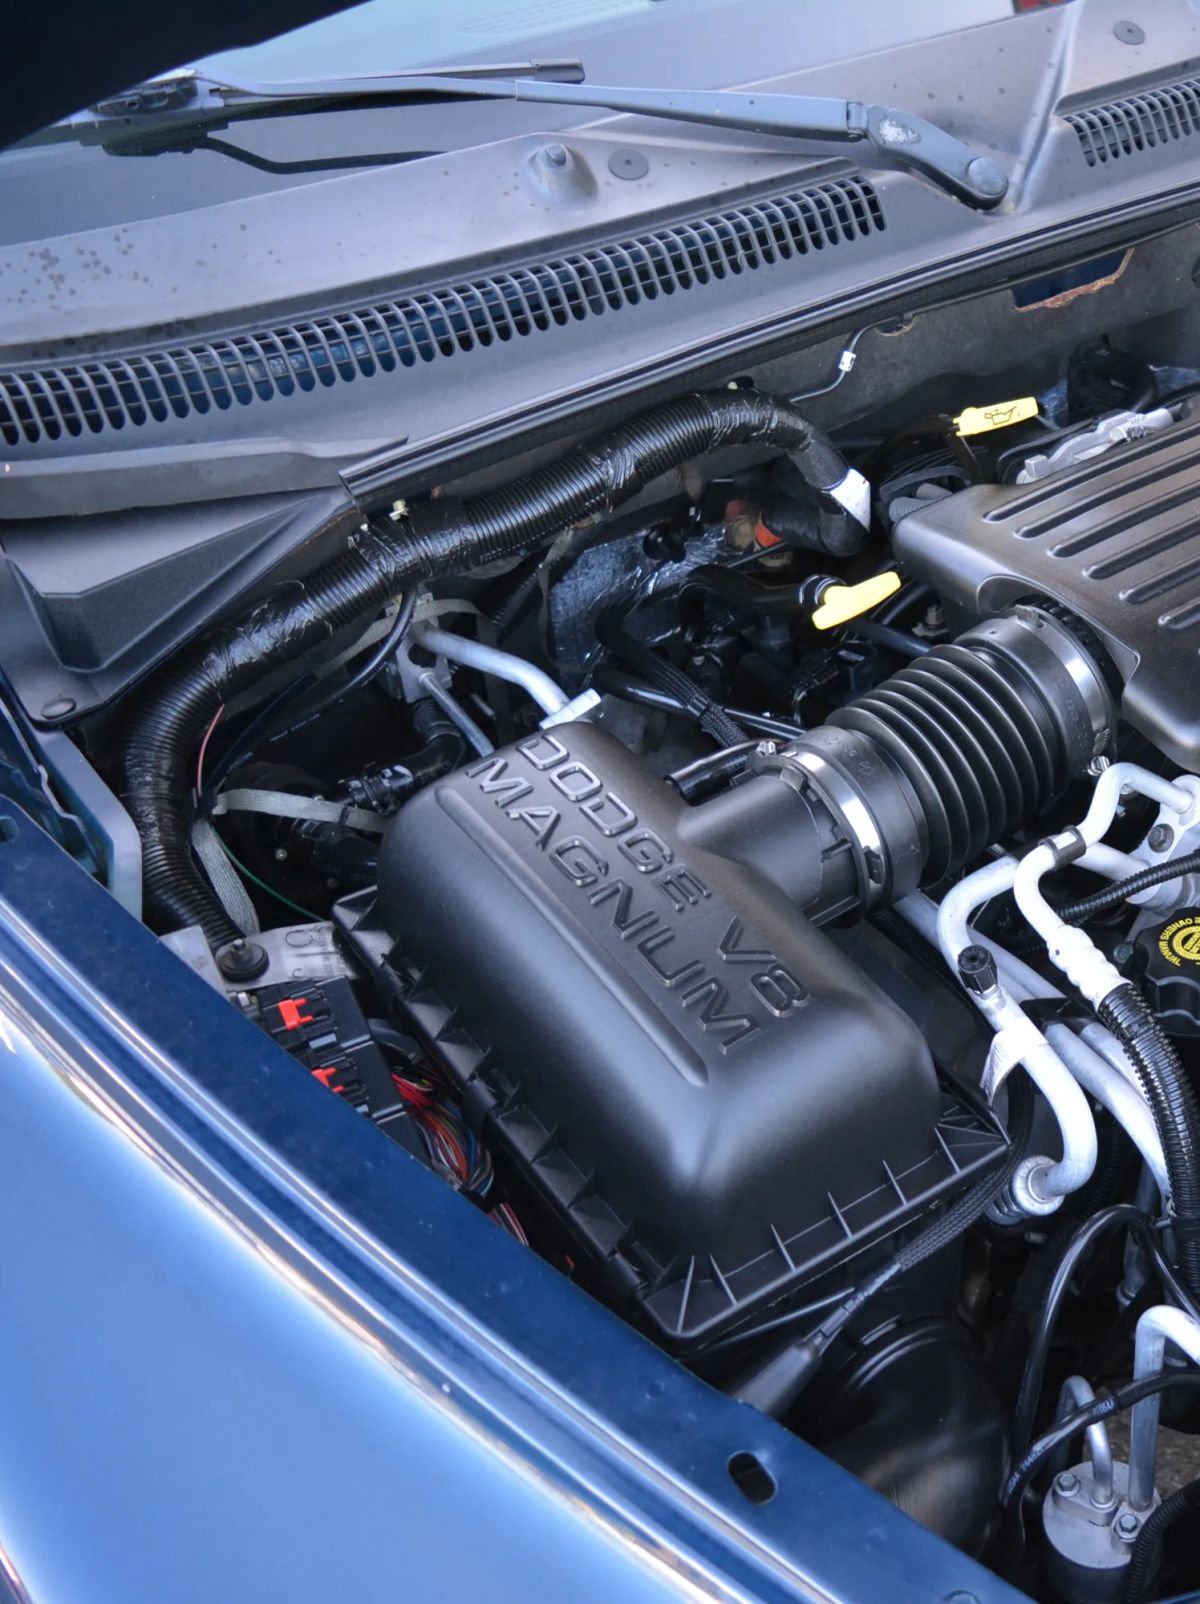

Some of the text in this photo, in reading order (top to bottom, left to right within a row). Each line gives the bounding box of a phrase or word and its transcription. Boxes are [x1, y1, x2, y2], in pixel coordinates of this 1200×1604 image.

[465, 757, 762, 1055] MAGNUM
[516, 734, 814, 1017] DODGE V8
[1159, 940, 1181, 967] MANUAL
